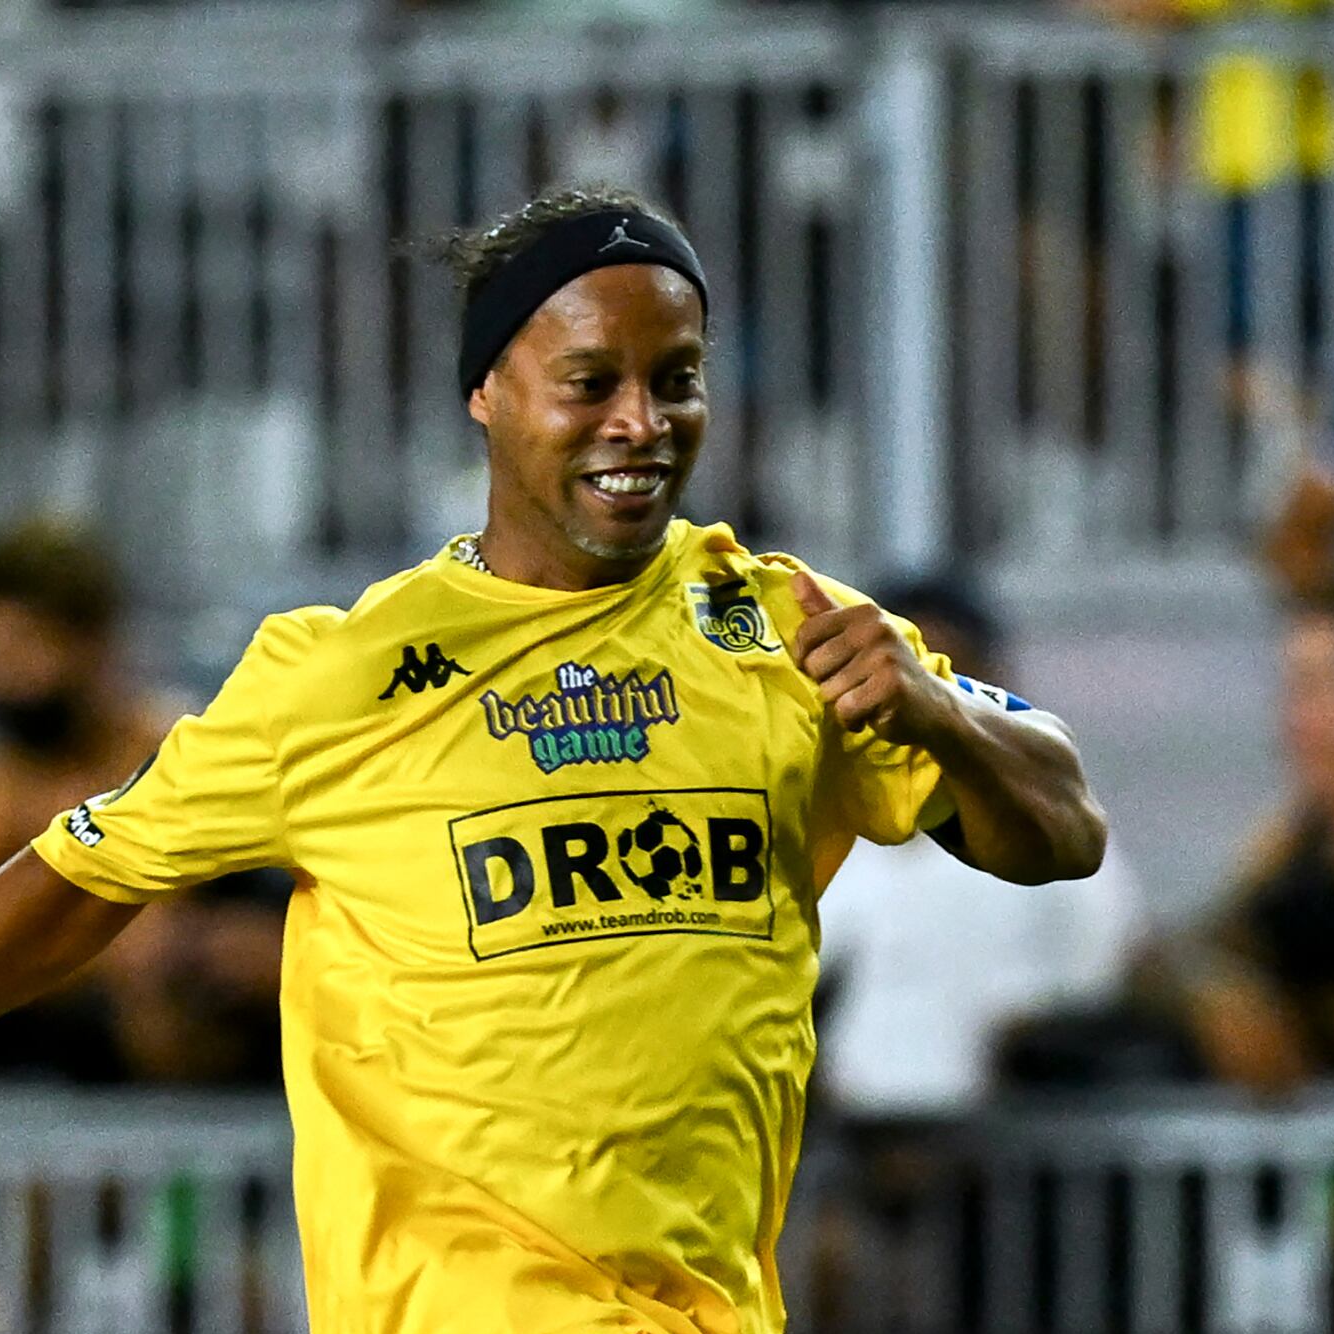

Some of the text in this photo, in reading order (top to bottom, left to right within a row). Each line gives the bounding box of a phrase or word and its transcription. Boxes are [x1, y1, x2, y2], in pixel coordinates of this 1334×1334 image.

[558, 663, 596, 690] the
[485, 674, 679, 737] beautiful
[532, 725, 649, 771] game
[541, 909, 721, 937] www.teamdrob.com
